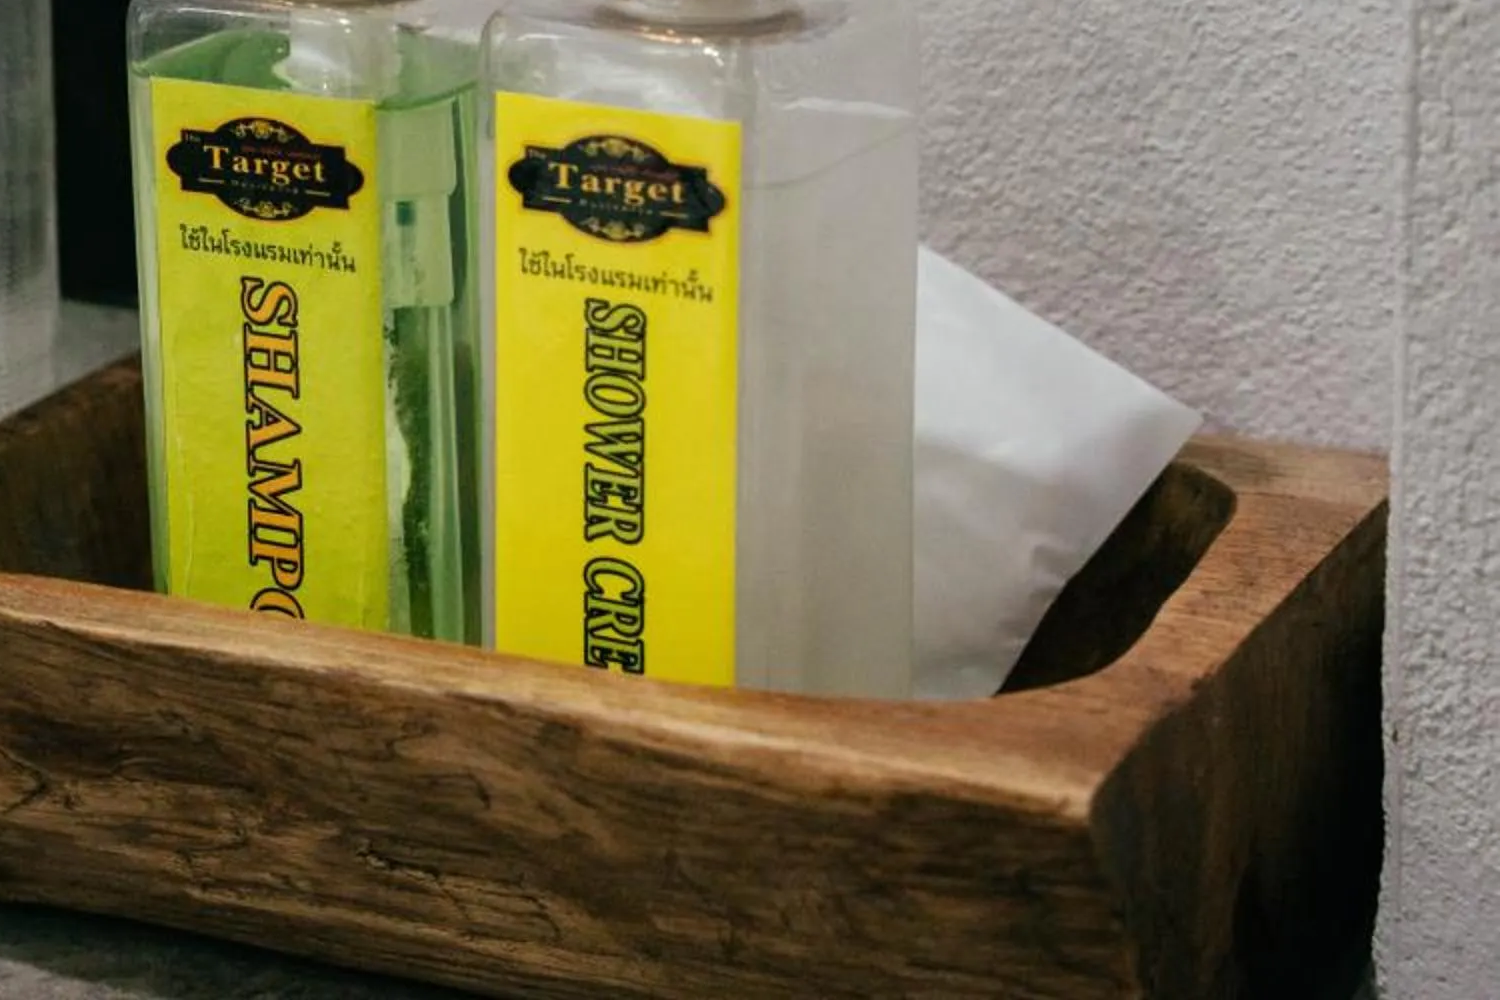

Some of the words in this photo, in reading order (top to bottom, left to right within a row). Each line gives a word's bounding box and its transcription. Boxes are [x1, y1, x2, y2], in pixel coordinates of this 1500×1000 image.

[203, 144, 328, 186] Target
[547, 160, 686, 207] Target
[179, 222, 357, 273] ใช้ในโรงแรมเท่านั้น
[518, 247, 714, 302] ใช้ในโรงแรมเท่านั้น
[583, 297, 648, 545] SHOWER
[583, 556, 646, 676] CRE
